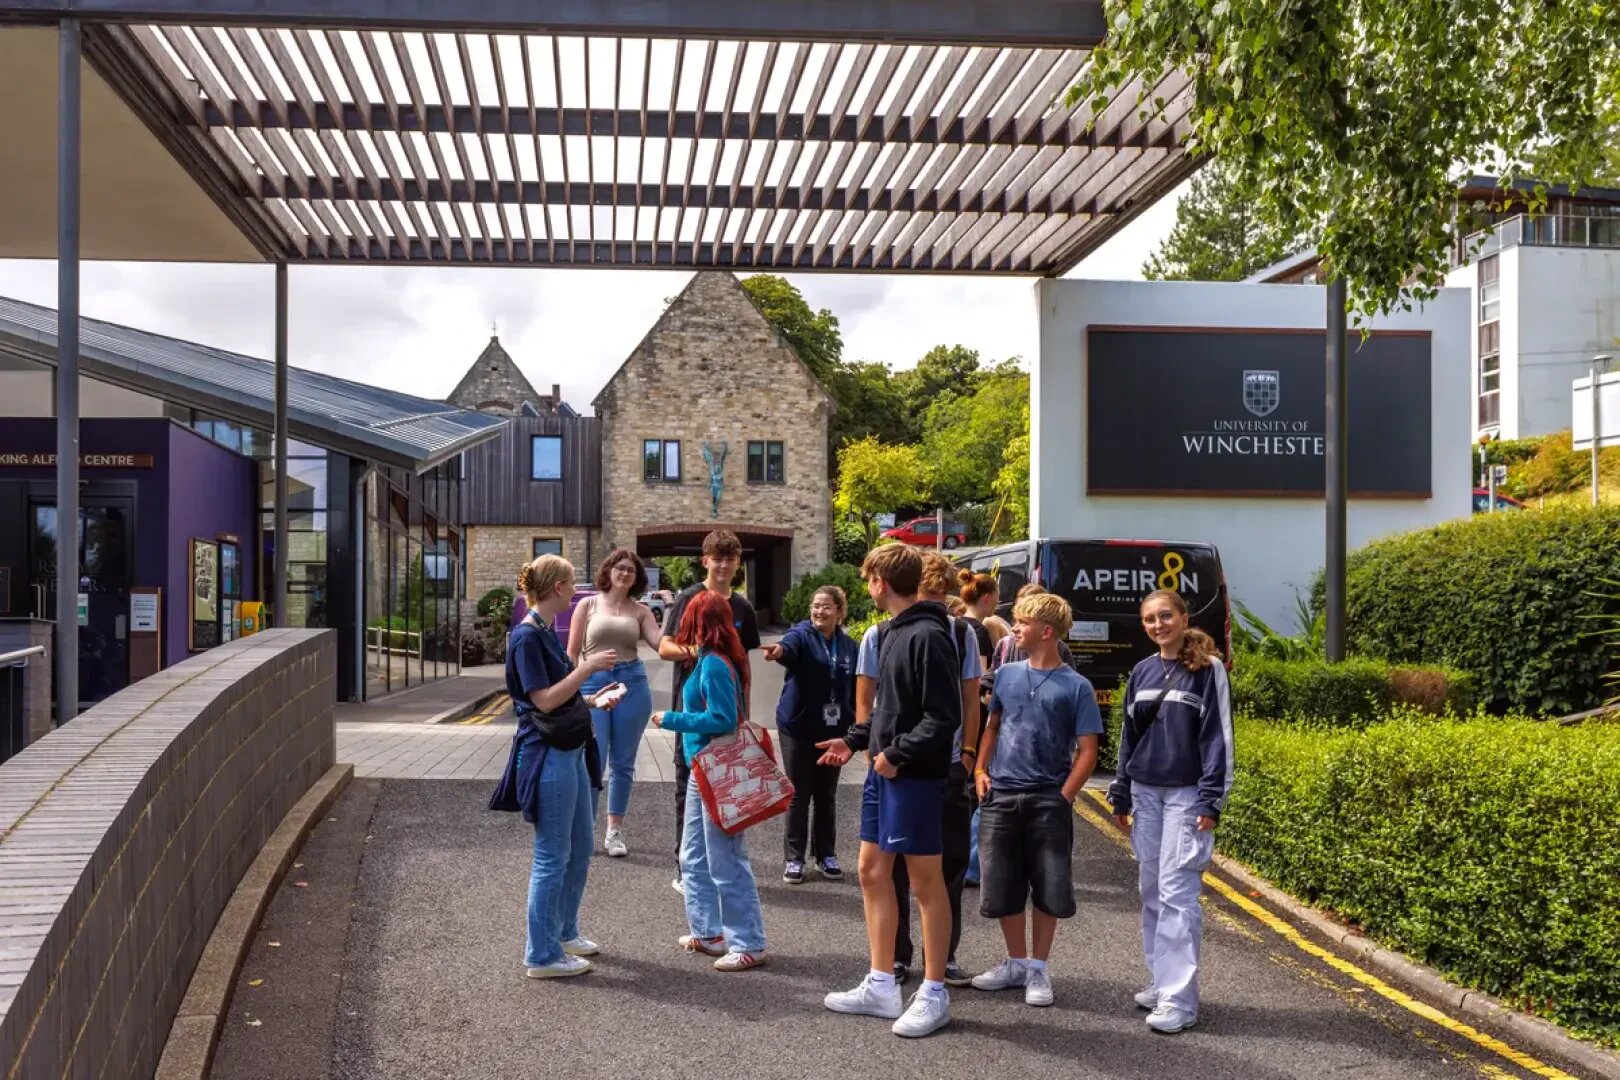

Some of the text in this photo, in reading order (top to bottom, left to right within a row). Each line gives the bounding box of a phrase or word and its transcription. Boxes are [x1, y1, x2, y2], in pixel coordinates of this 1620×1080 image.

[1214, 420, 1309, 432] UNIVERSITY OF
[1182, 435, 1324, 456] WINCHESTE
[0, 454, 28, 465] KING
[84, 455, 134, 466] CENTRE
